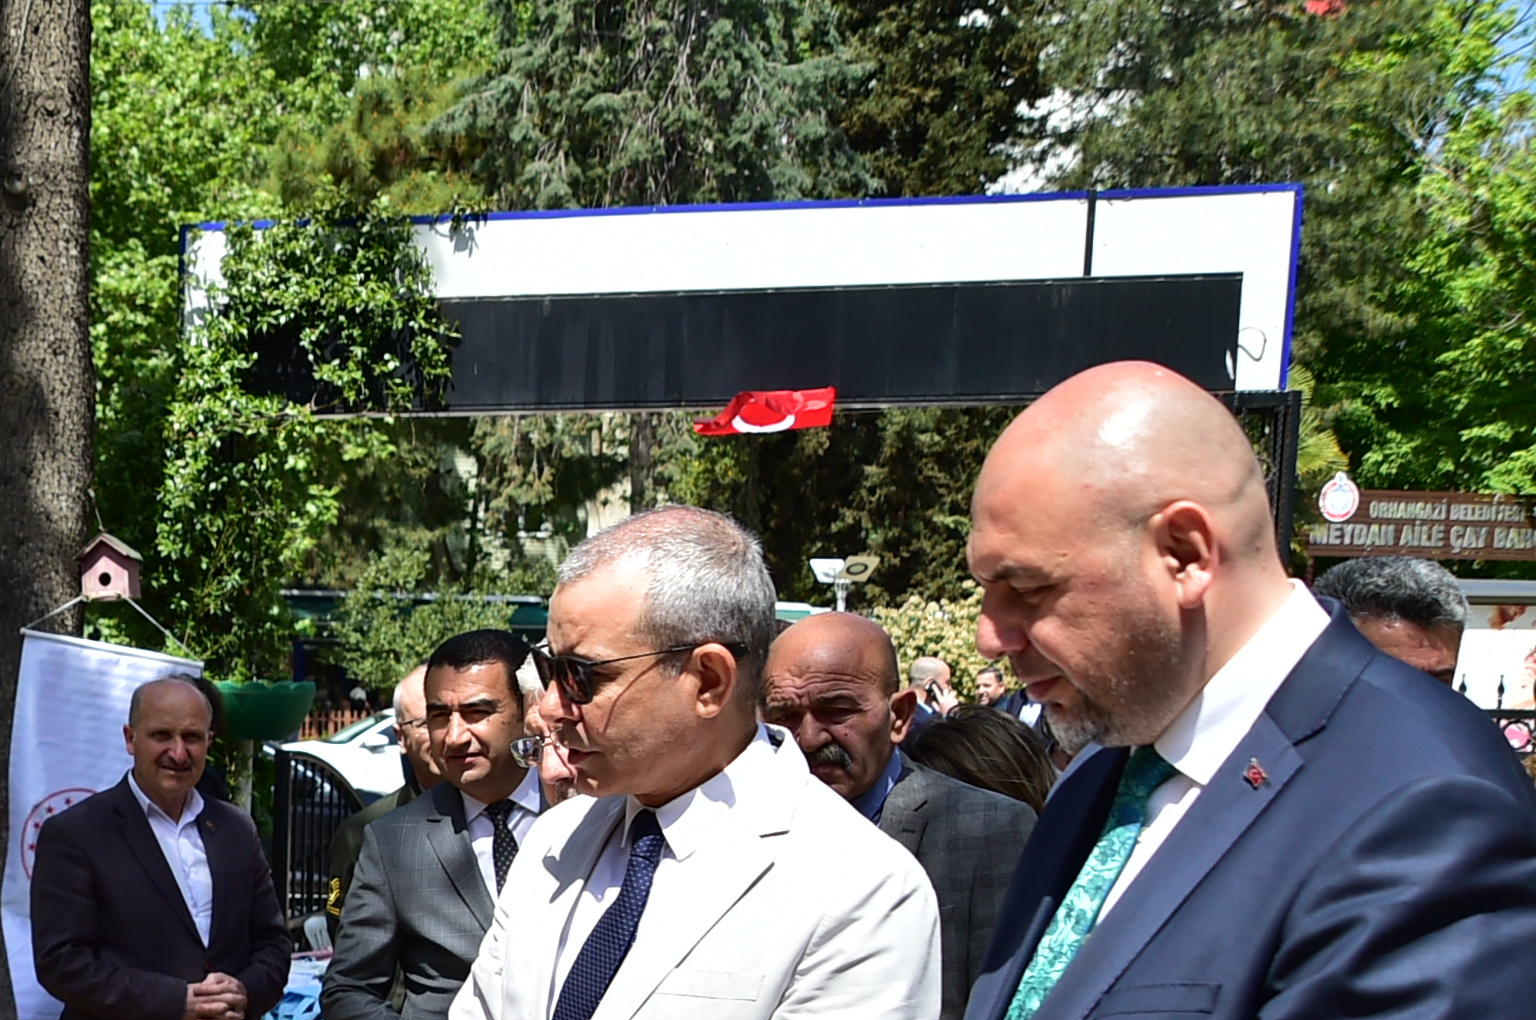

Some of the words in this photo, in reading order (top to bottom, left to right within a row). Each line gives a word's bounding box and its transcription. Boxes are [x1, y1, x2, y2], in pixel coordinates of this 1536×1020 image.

[1369, 499, 1447, 520] ORHANGAZİ
[1309, 523, 1396, 546] MEYDAN
[1399, 520, 1445, 547] AİLE
[1449, 525, 1489, 554] ÇAY
[1493, 527, 1536, 550] BAH
